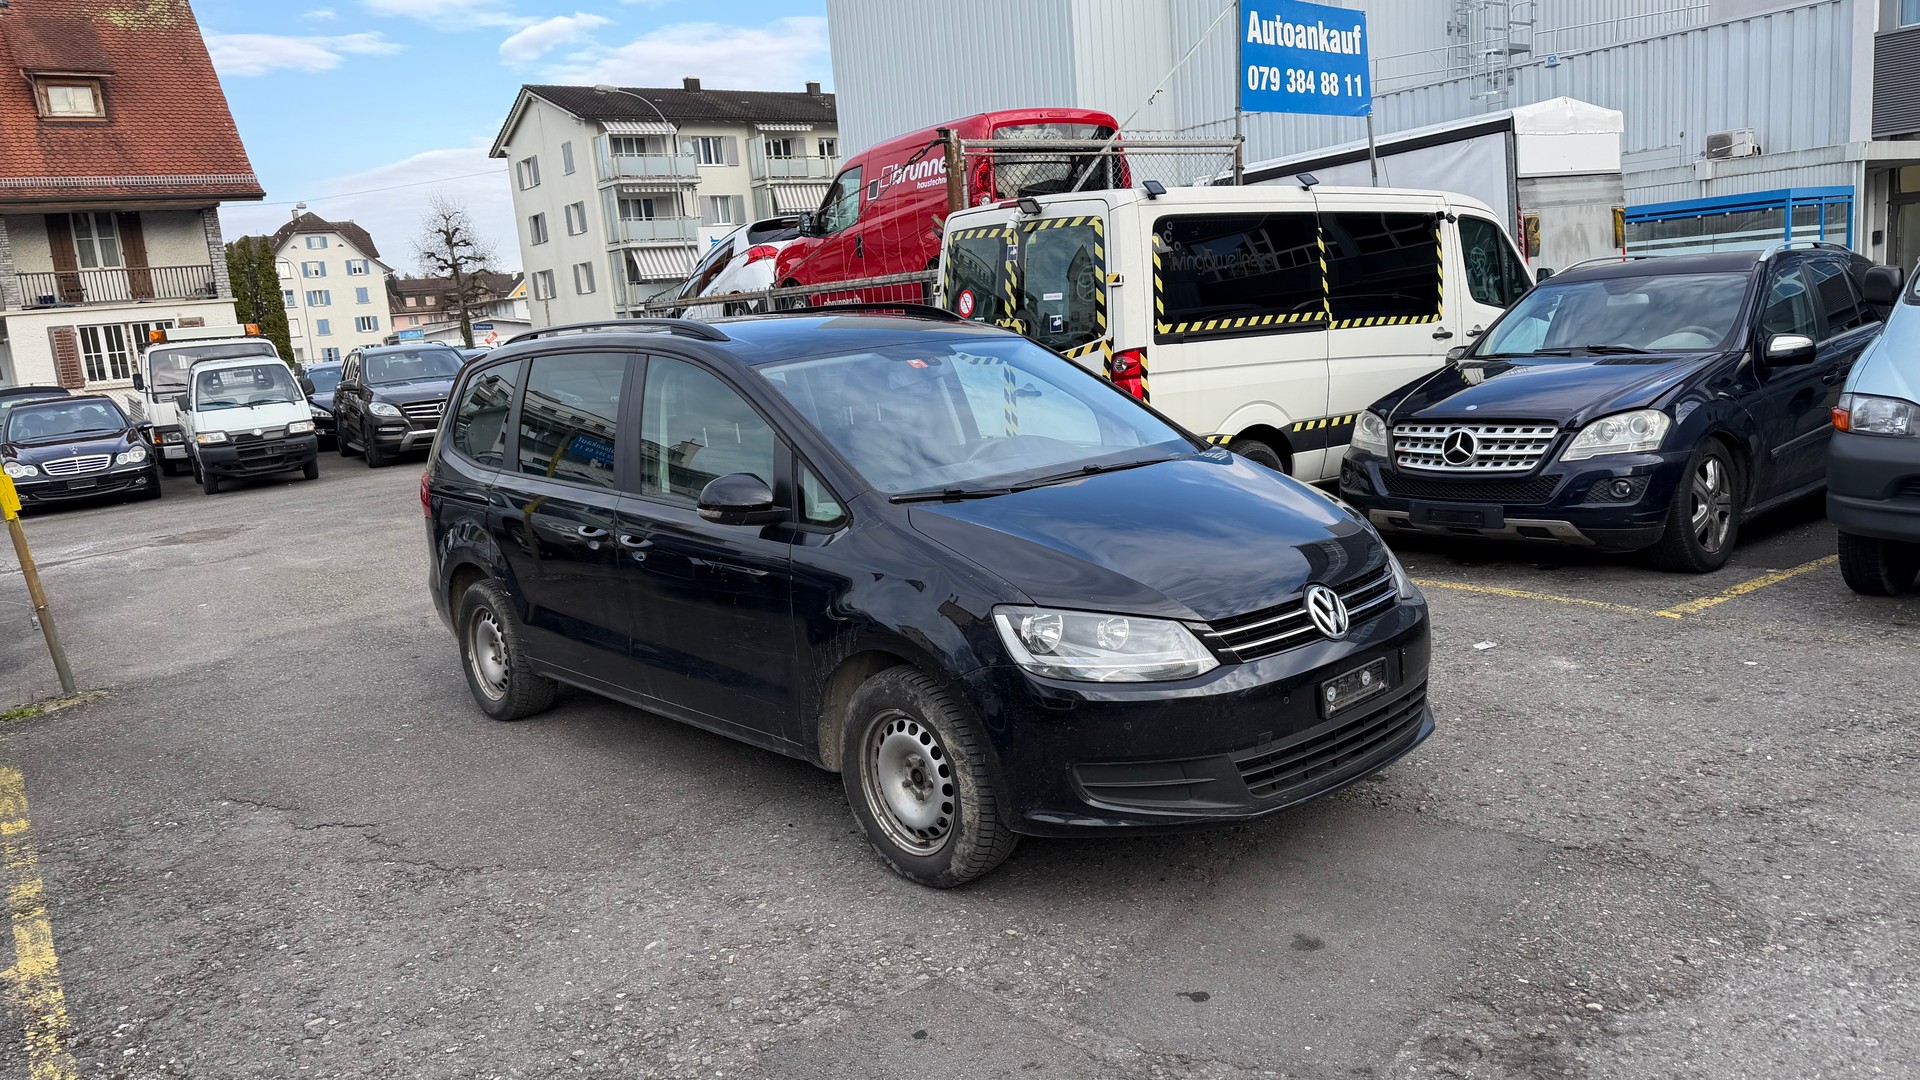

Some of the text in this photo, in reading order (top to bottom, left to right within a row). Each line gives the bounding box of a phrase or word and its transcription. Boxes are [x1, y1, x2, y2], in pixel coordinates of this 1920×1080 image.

[1247, 11, 1361, 55] Autoankauf
[1247, 65, 1362, 97] 079 384 88 11
[892, 156, 946, 185] brunne
[917, 177, 947, 189] haustechni
